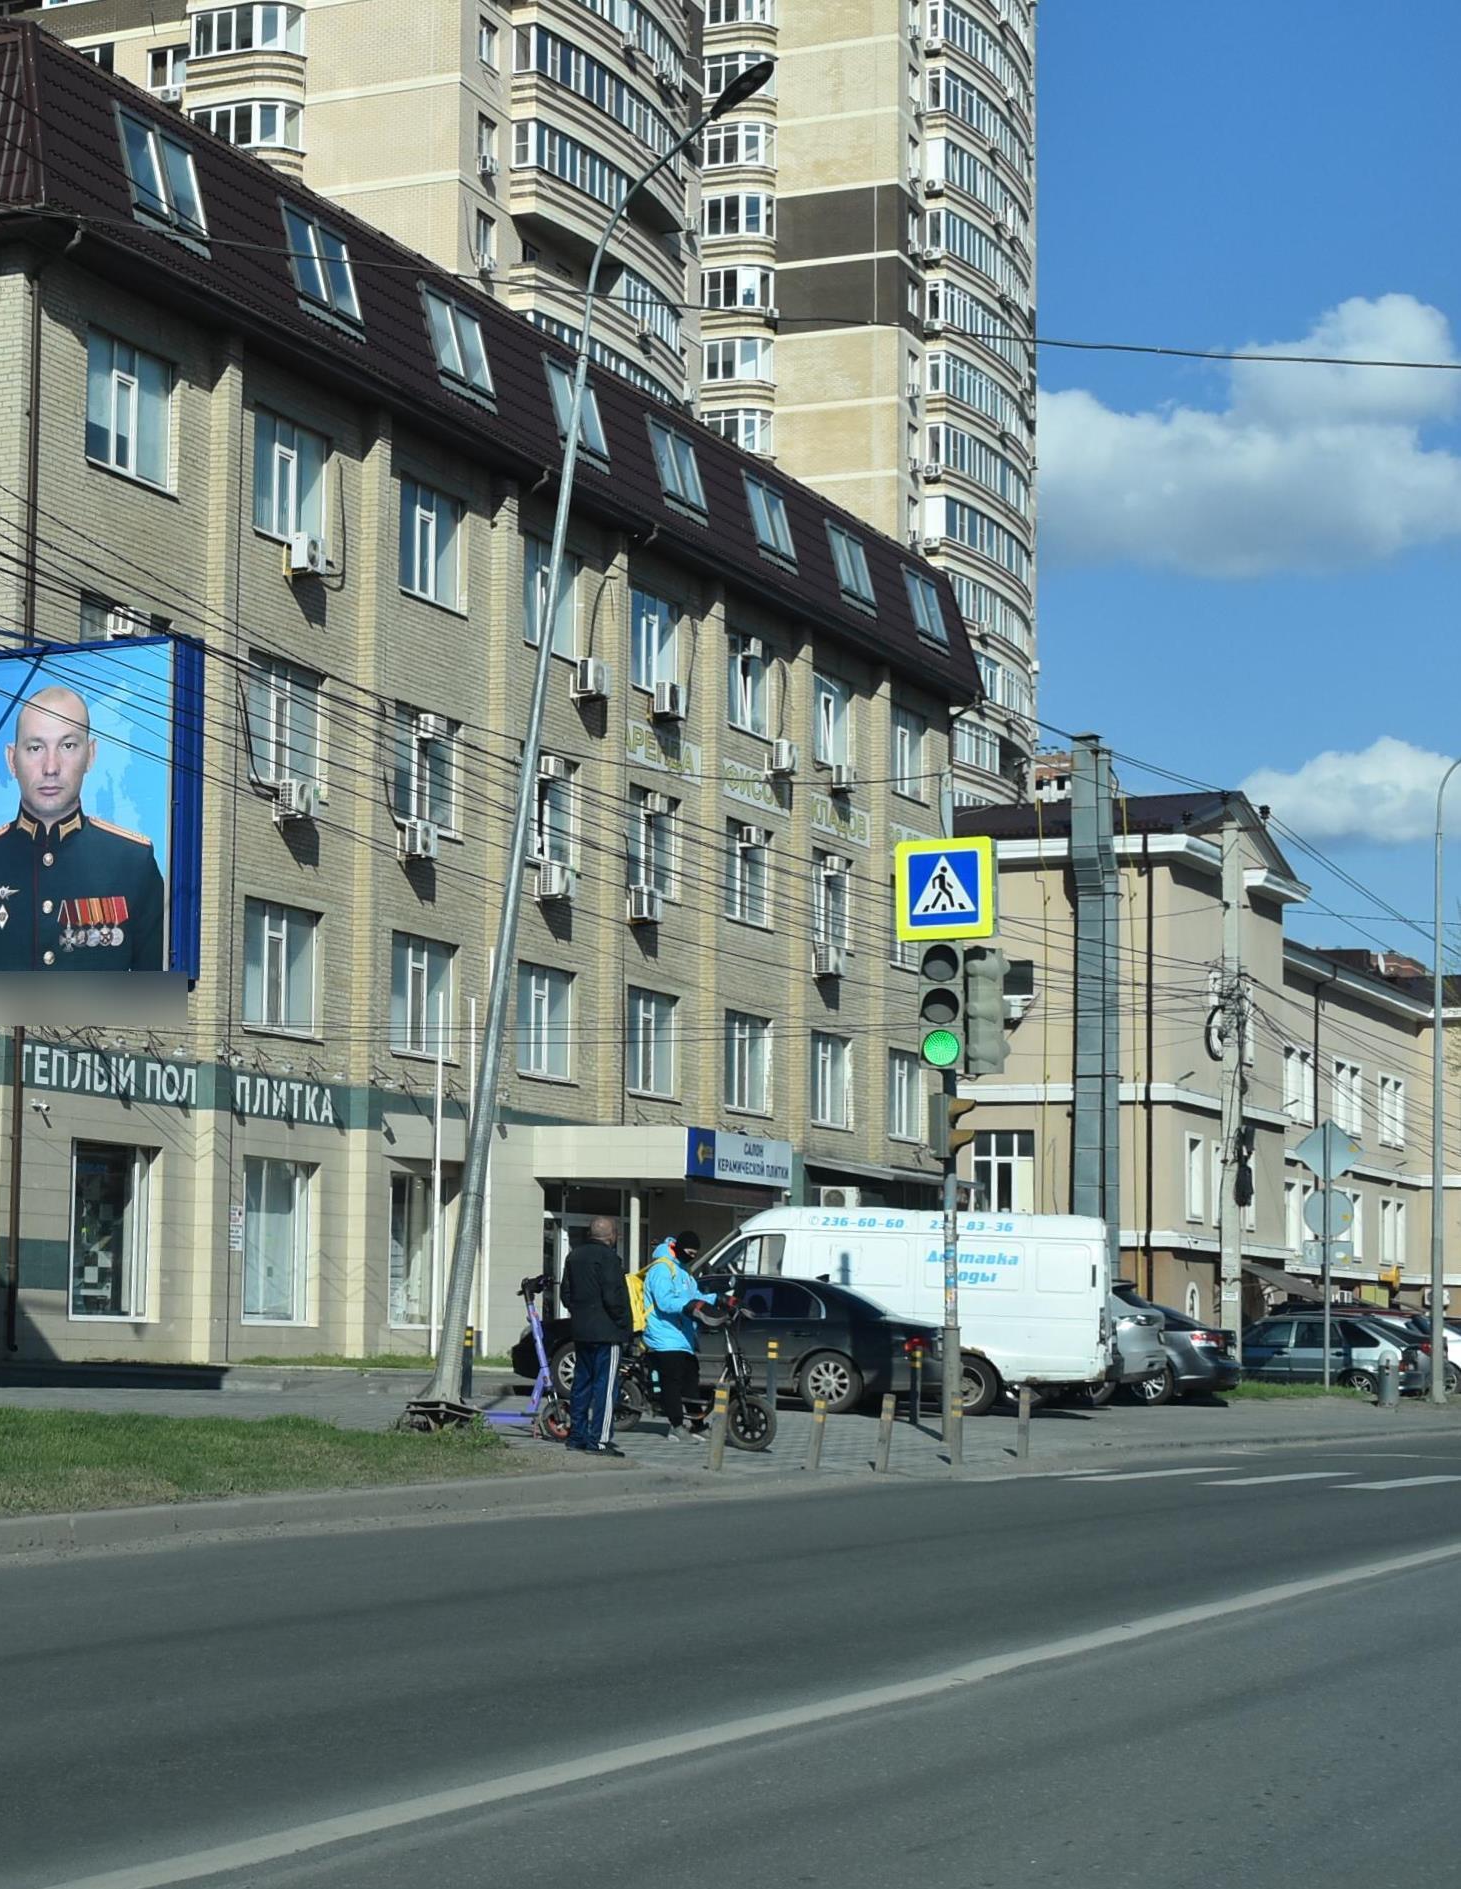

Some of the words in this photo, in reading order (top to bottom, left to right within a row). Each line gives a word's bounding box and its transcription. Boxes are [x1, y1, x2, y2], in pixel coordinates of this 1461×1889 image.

[144, 1062, 197, 1104] ПОЛ
[236, 1075, 335, 1124] ПЛИТКА
[744, 1143, 764, 1157] САЛОН
